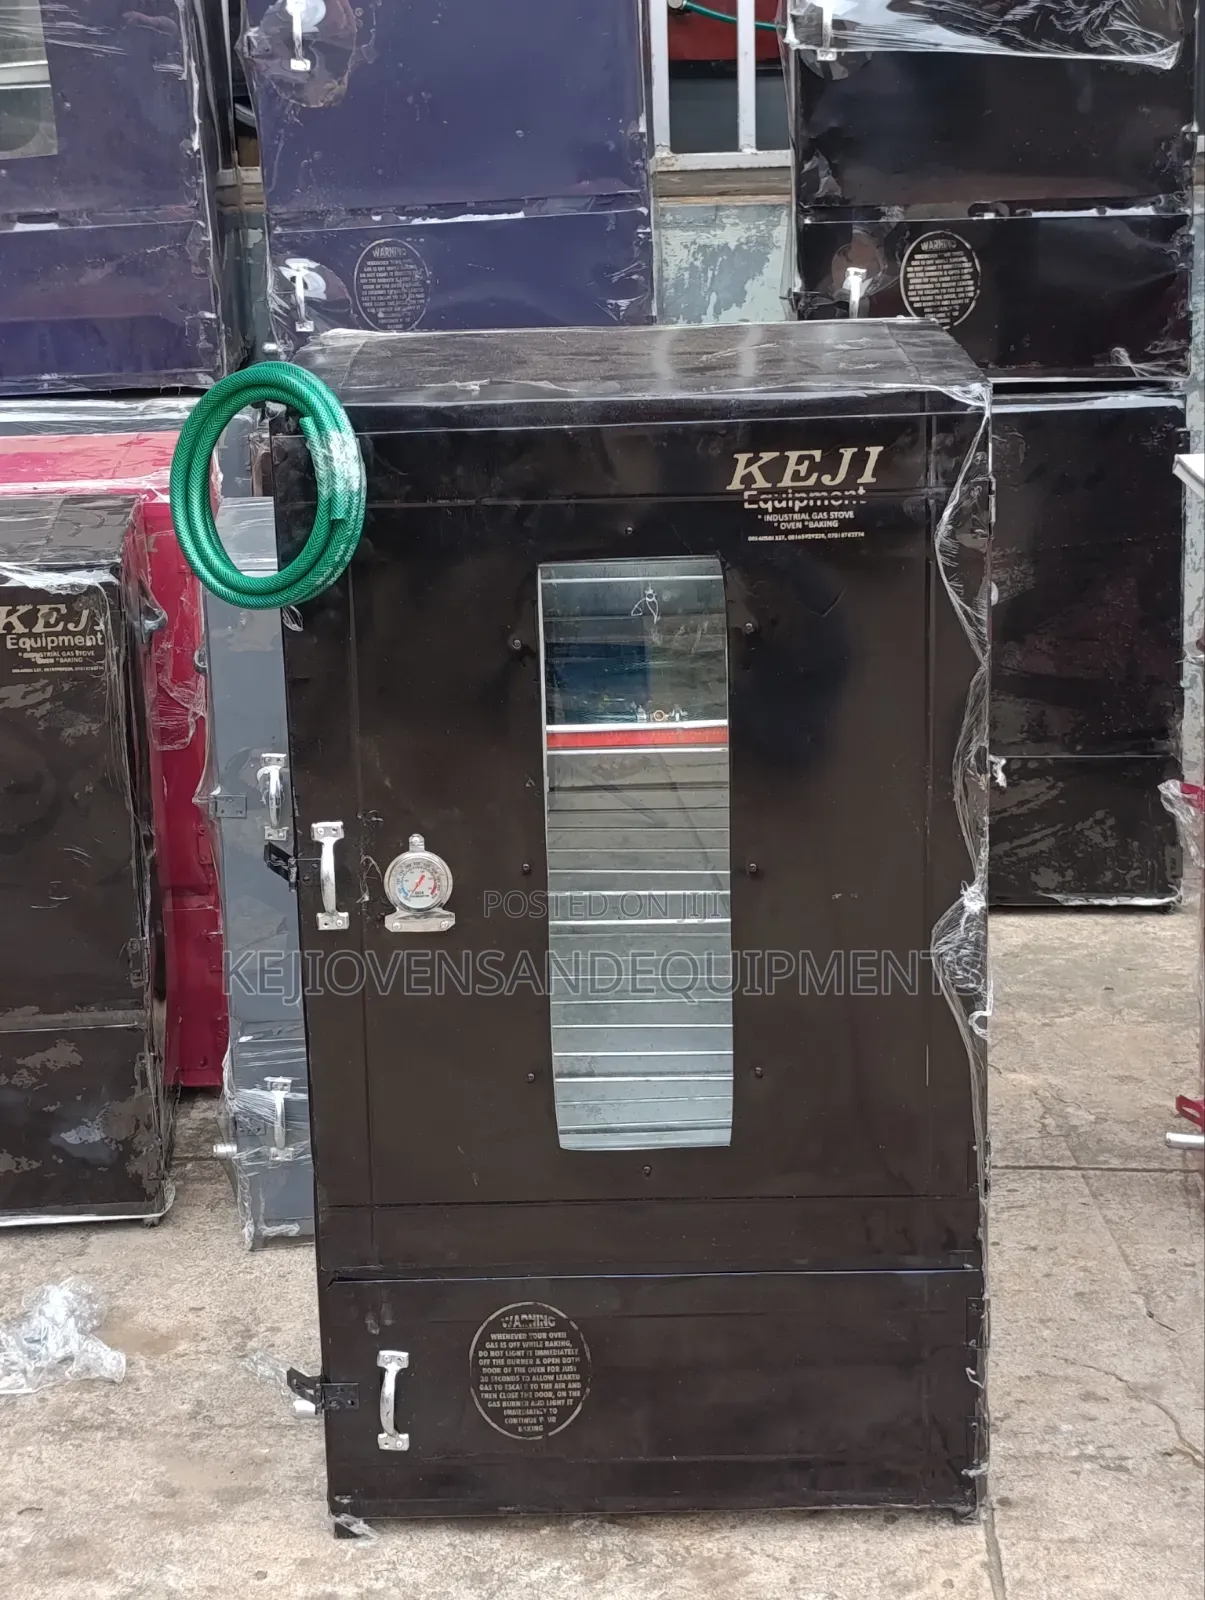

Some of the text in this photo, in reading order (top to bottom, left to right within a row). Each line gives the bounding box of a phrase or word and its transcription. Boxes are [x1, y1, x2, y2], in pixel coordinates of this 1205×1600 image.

[726, 446, 885, 491] KEJI
[743, 486, 868, 512] Equipment
[764, 511, 855, 522] INDUSTRIAL GAS STOVE
[780, 521, 802, 530] OVEN
[0, 603, 104, 634] KEJ
[6, 632, 105, 652] Equipment
[500, 1314, 556, 1328] WARNING
[485, 1341, 499, 1349] GAS
[478, 1350, 489, 1358] DO
[478, 1358, 491, 1366] OFF
[492, 1358, 505, 1366] THE
[547, 1365, 561, 1373] FOR
[540, 1382, 553, 1390] THE
[567, 1381, 582, 1389] AND
